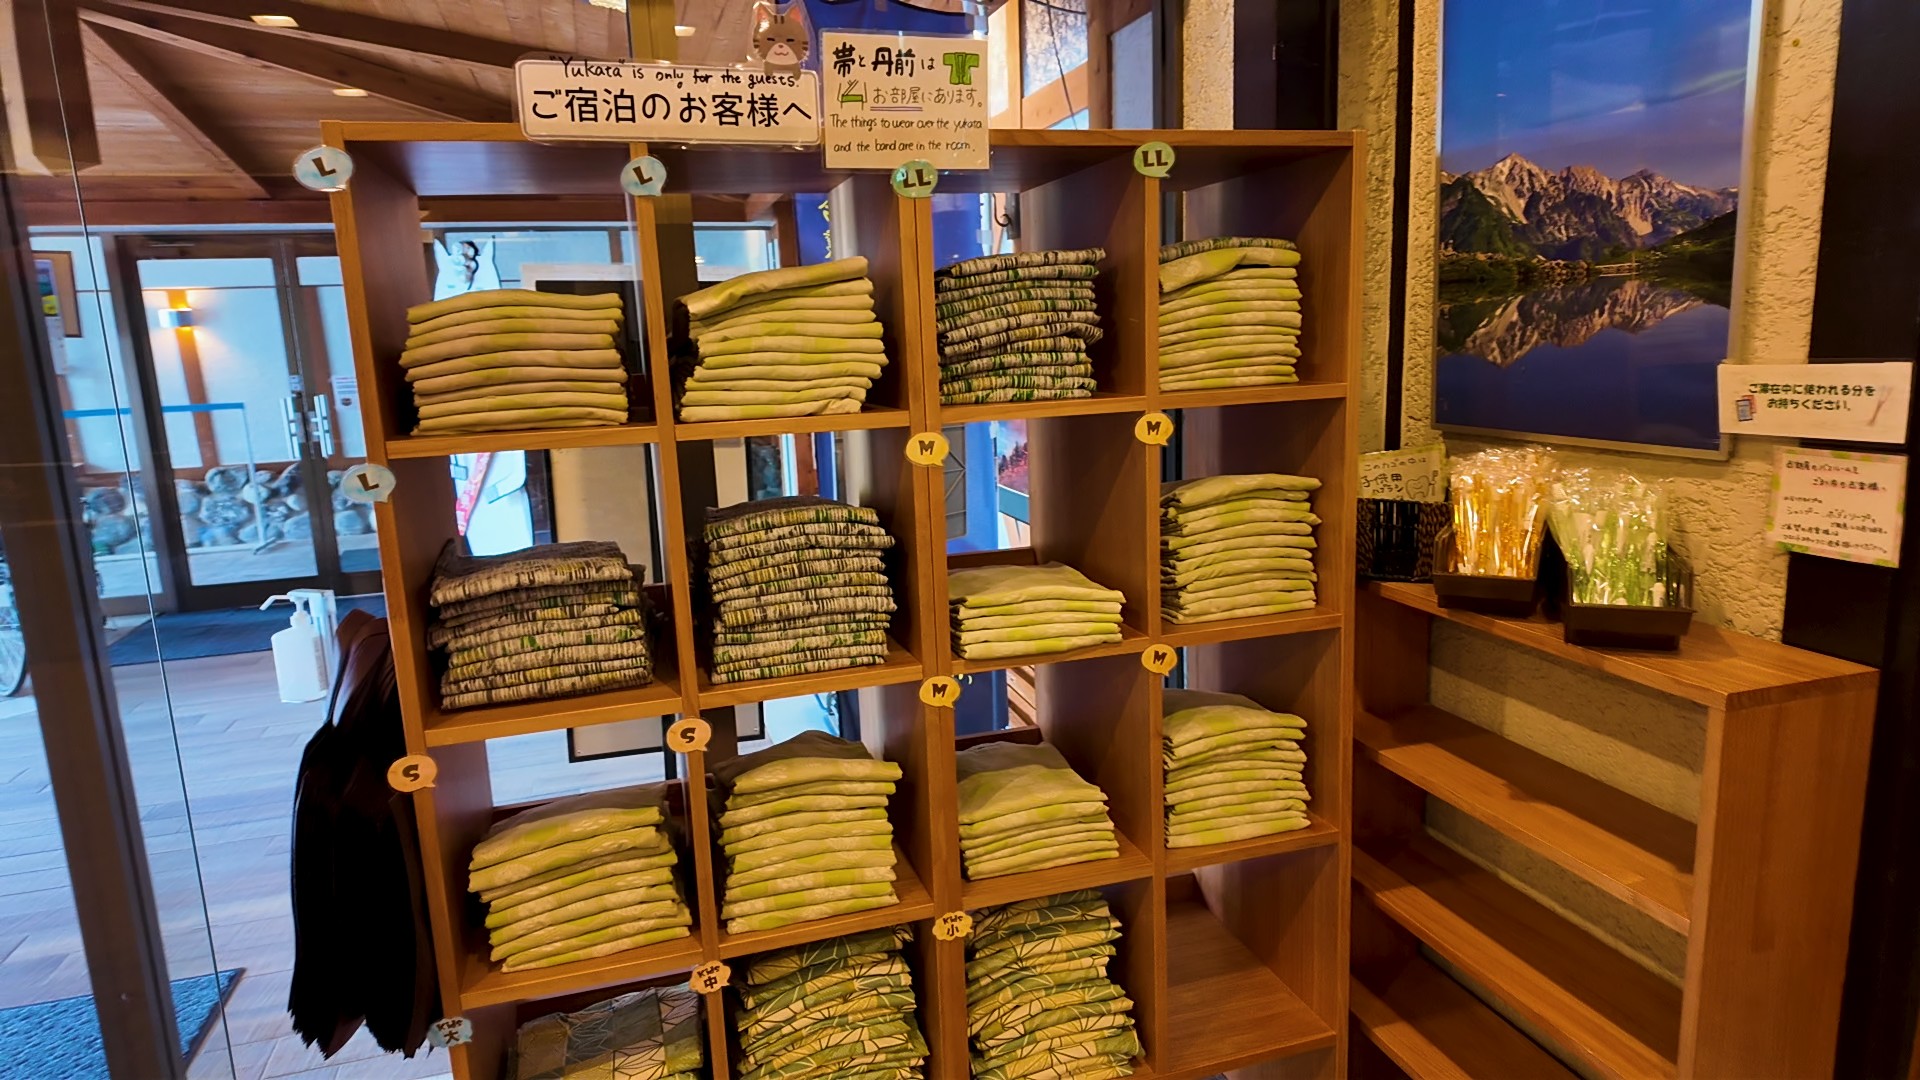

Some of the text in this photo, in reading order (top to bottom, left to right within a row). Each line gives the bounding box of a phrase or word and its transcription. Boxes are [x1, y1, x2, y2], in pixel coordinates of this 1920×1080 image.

[832, 42, 935, 77] 帯と丹前は
[632, 65, 644, 79] is
[656, 69, 684, 89] only
[693, 70, 710, 84] for
[721, 69, 741, 84] the
[873, 87, 983, 108] お部屋にあります。
[532, 87, 812, 127] ご宿泊のお客様へ
[830, 113, 982, 132] The things to wear over the yukata
[833, 141, 851, 152] and
[857, 140, 870, 152] the
[898, 142, 913, 151] are
[916, 142, 925, 150] in
[928, 139, 942, 150] the
[312, 157, 336, 177] L
[1142, 150, 1168, 168] LL
[633, 166, 654, 185] L
[903, 169, 931, 188] LL
[1146, 420, 1162, 435] M
[918, 440, 935, 455] M
[357, 473, 379, 491] L
[1361, 473, 1402, 488] 子供用
[1153, 650, 1168, 665] M
[932, 684, 948, 698] M
[680, 727, 696, 743] S
[402, 764, 420, 782] S
[947, 924, 959, 937] 小
[704, 976, 718, 989] 中
[443, 1030, 460, 1044] 大
